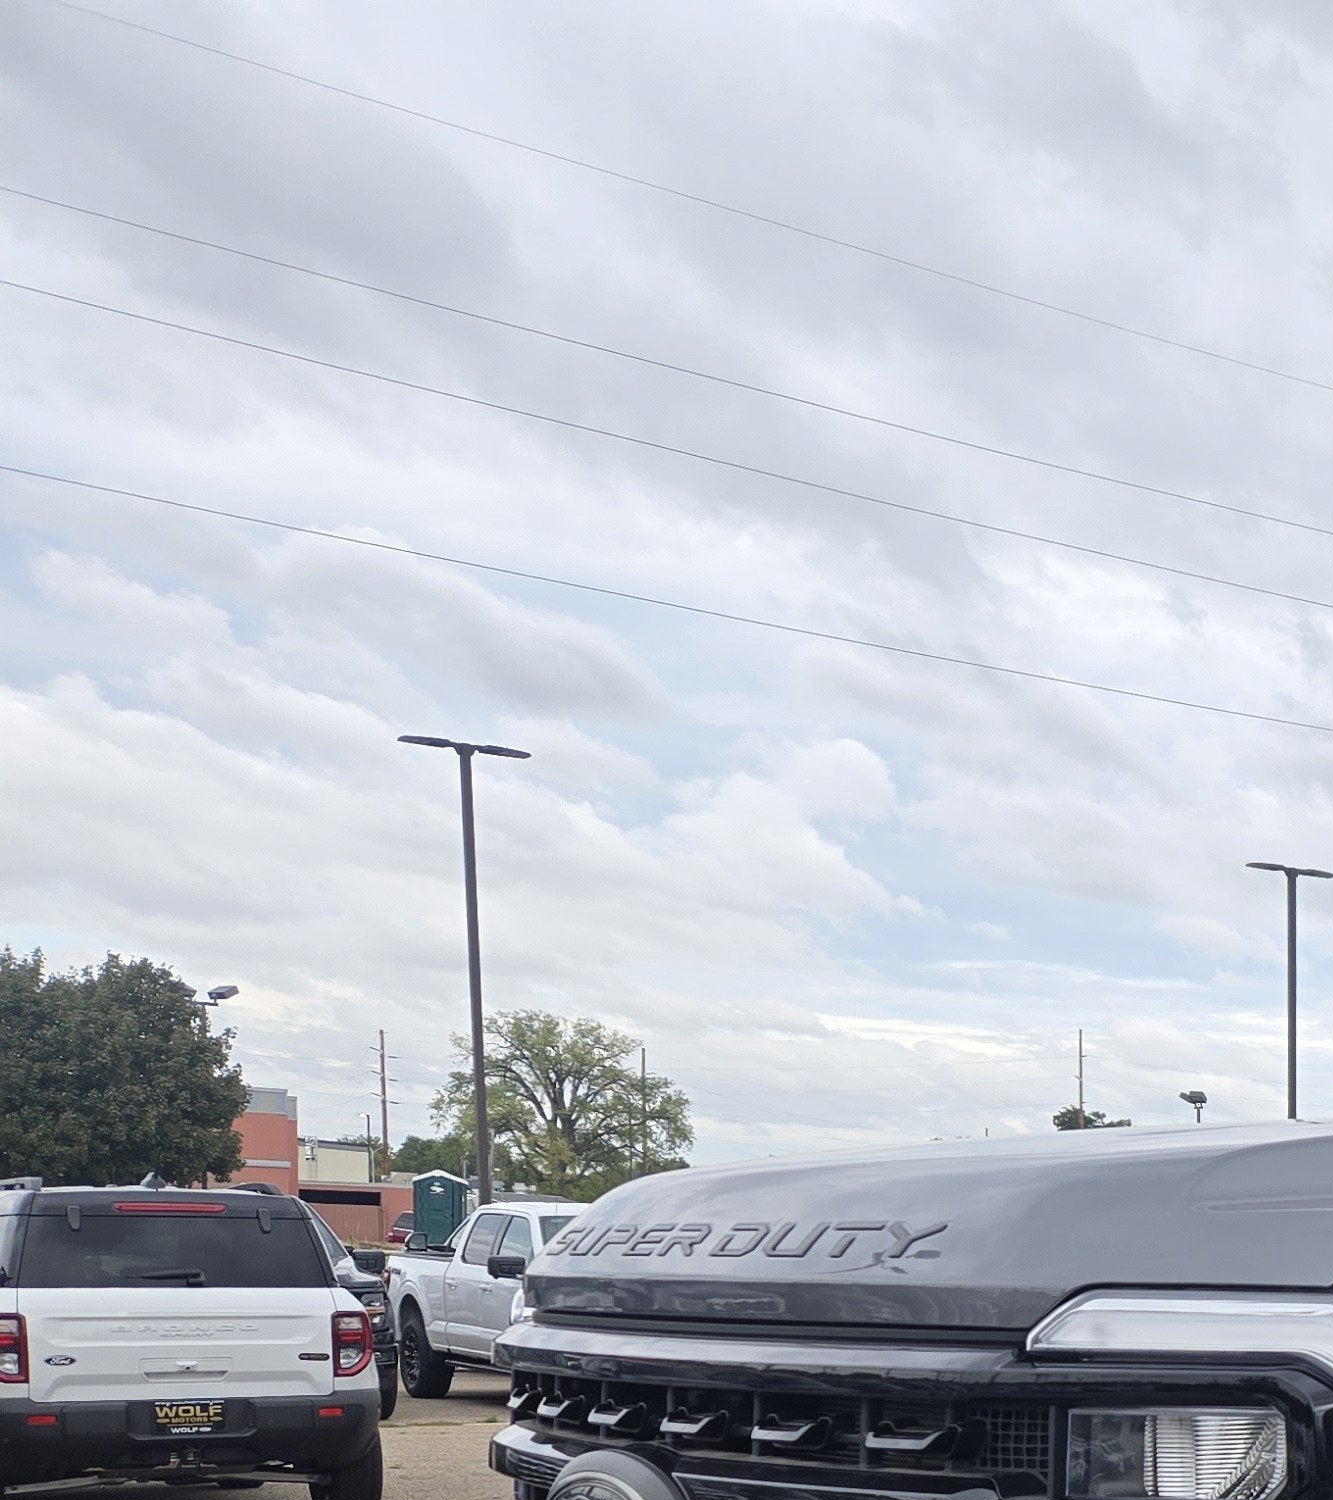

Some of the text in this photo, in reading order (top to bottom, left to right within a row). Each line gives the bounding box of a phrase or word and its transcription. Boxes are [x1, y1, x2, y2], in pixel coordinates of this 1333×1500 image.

[546, 1220, 949, 1259] SUPER DUTY
[155, 1405, 222, 1417] WOLF
